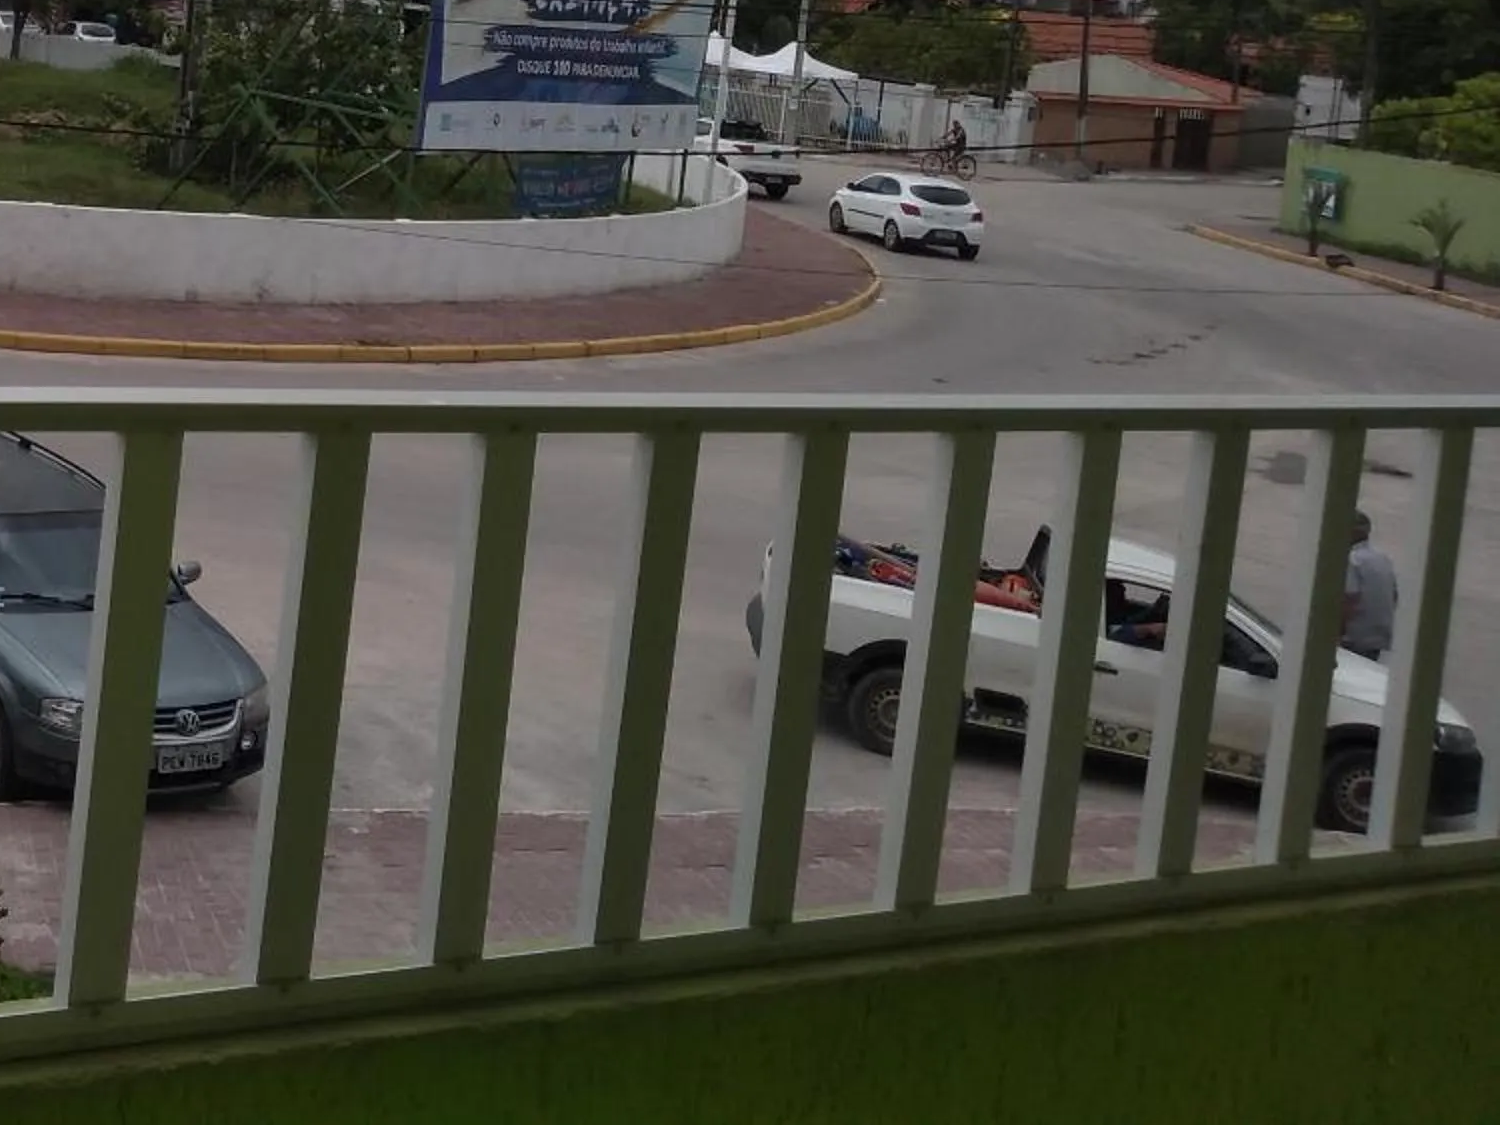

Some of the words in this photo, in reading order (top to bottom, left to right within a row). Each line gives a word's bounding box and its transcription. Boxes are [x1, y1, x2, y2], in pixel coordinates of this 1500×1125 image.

[514, 34, 548, 50] compre
[549, 36, 589, 52] produtos
[516, 58, 552, 75] DISQUE
